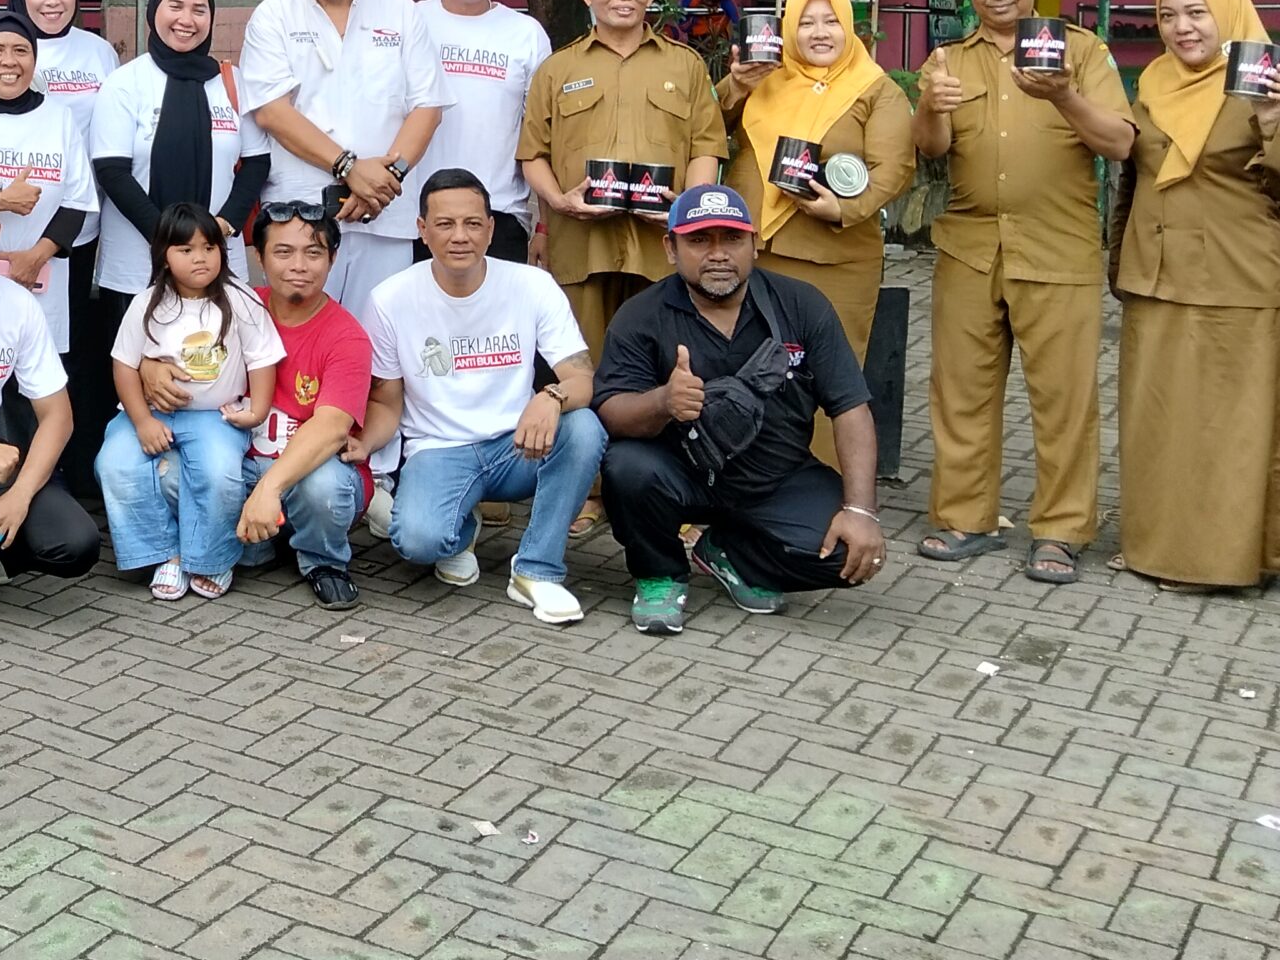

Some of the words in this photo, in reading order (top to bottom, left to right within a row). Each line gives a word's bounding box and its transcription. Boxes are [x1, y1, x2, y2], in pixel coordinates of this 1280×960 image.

[441, 46, 509, 68] DEKLARASI
[43, 68, 99, 83] DEKLARASI
[444, 62, 463, 72] ANTI
[463, 64, 506, 78] BULLYING
[48, 83, 67, 91] ANTI
[451, 333, 521, 356] DEKLARASI
[455, 356, 477, 368] ANTI
[477, 353, 522, 367] BULLYING
